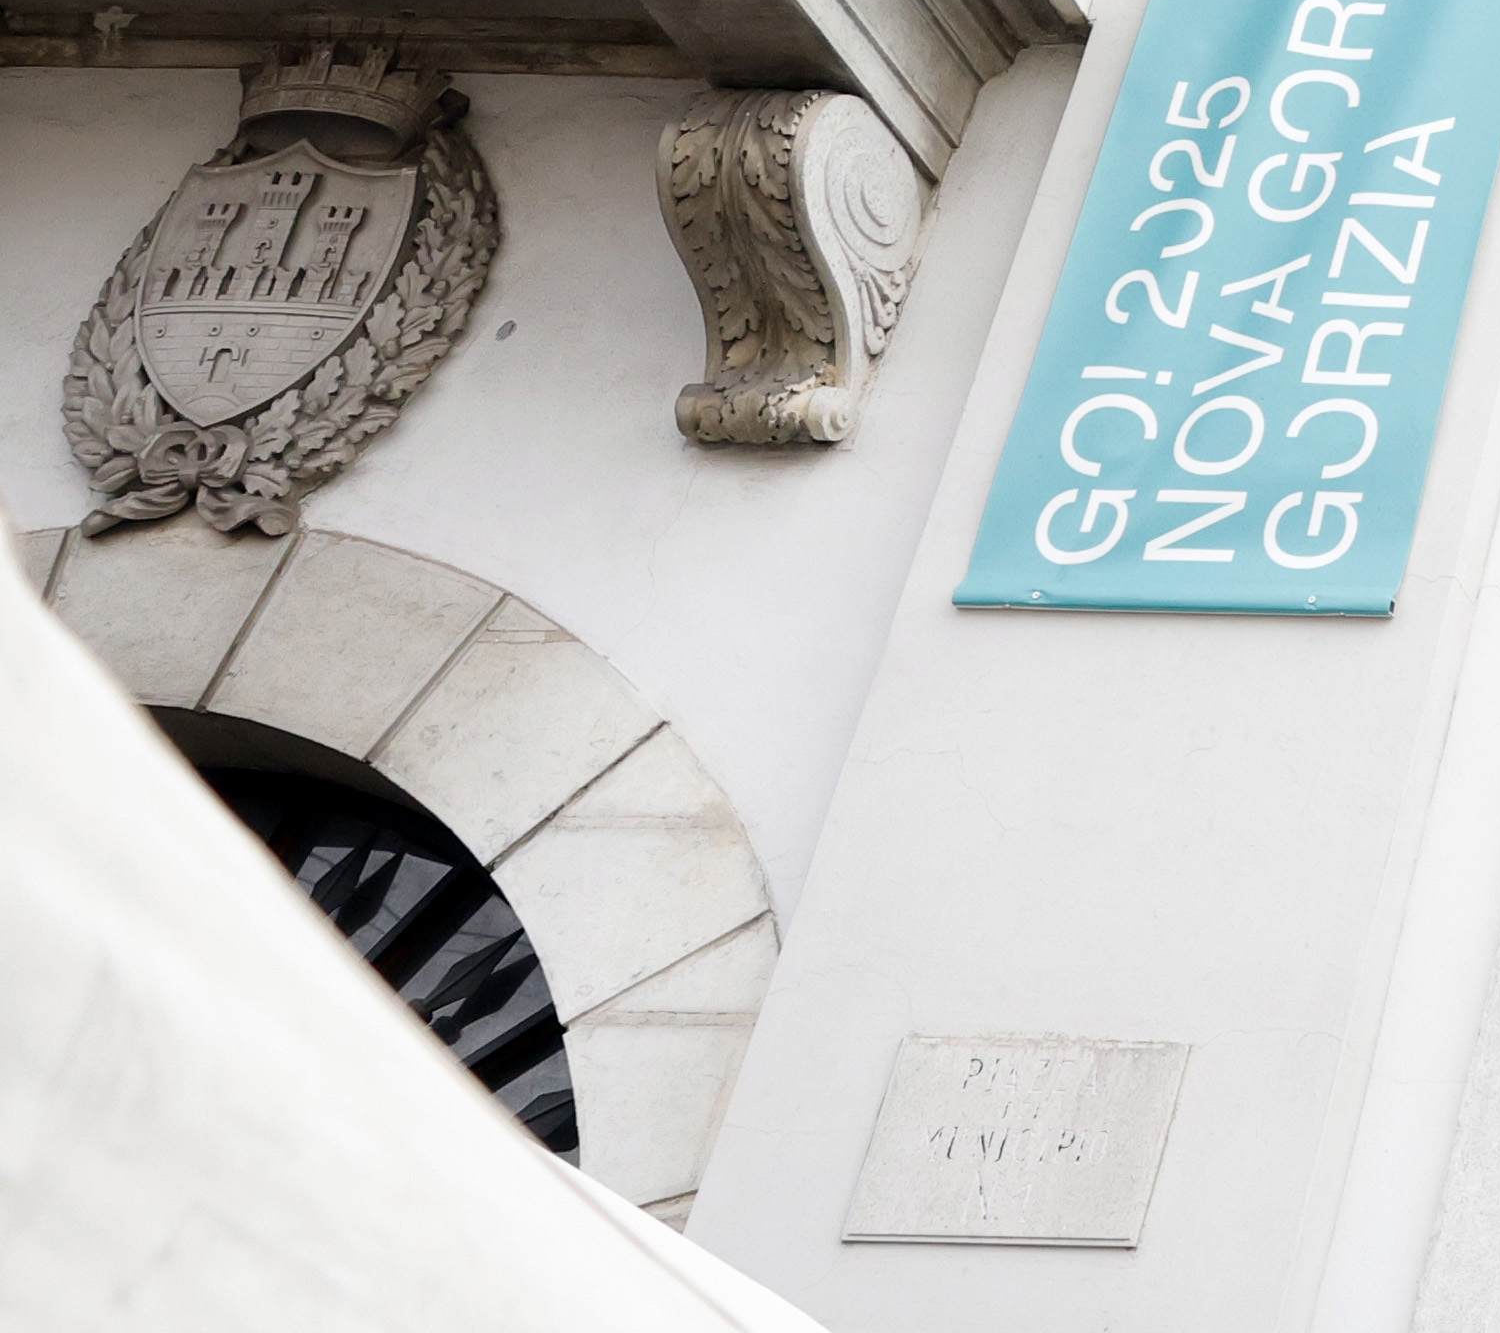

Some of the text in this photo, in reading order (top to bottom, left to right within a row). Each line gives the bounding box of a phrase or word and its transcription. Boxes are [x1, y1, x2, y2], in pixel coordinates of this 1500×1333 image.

[1035, 76, 1251, 565] GO! 2025
[1142, 254, 1311, 563] NOVA
[1263, 116, 1456, 570] GORIZIA
[928, 1125, 1110, 1165] MUNICIPIO
[961, 1055, 1099, 1096] PIAZZA
